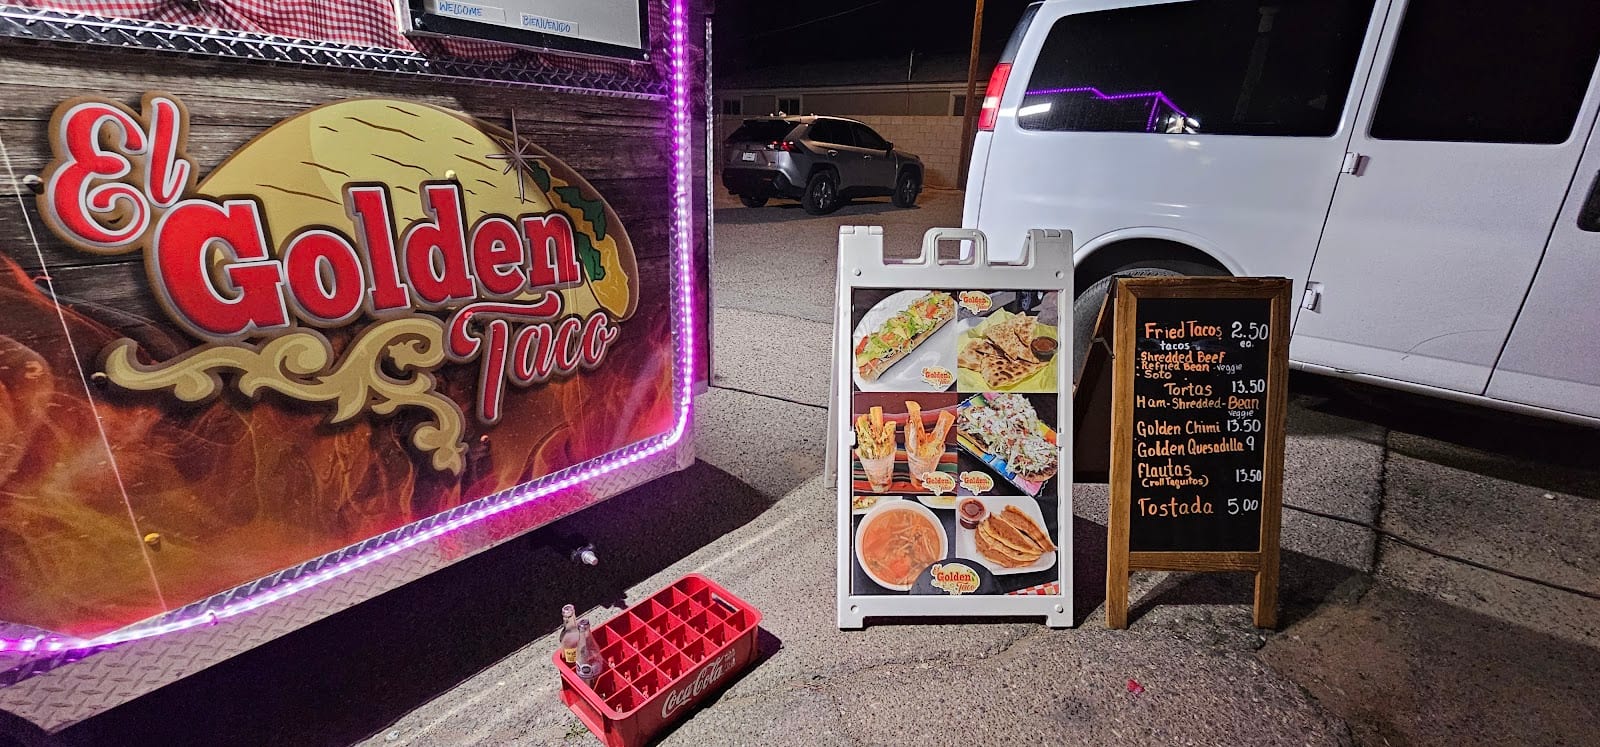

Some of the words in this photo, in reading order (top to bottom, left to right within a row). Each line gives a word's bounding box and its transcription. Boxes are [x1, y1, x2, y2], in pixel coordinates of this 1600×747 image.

[439, 3, 482, 17] WELCOME
[46, 96, 189, 246] El
[154, 180, 584, 339] Golden
[1145, 321, 1185, 339] Fried
[1185, 320, 1223, 337] Tacos
[1231, 321, 1269, 340] 2.50
[1159, 340, 1191, 350] tacos
[448, 293, 616, 424] Taco
[1140, 351, 1194, 364] Shredded
[1197, 351, 1226, 363] Beef
[1141, 361, 1181, 371] Refried
[1183, 362, 1210, 372] Bean
[1144, 368, 1173, 380] Soto
[1163, 382, 1213, 396] Tortas
[1231, 378, 1266, 394] 13.50
[1136, 420, 1181, 438] Golden
[1185, 420, 1222, 435] Chimi
[1226, 418, 1262, 433] 13.50
[1137, 440, 1186, 458] Golden
[1187, 437, 1245, 455] Quesadilla
[1245, 435, 1256, 451] 9
[1137, 494, 1215, 517] Tostada
[937, 571, 971, 582] Golden
